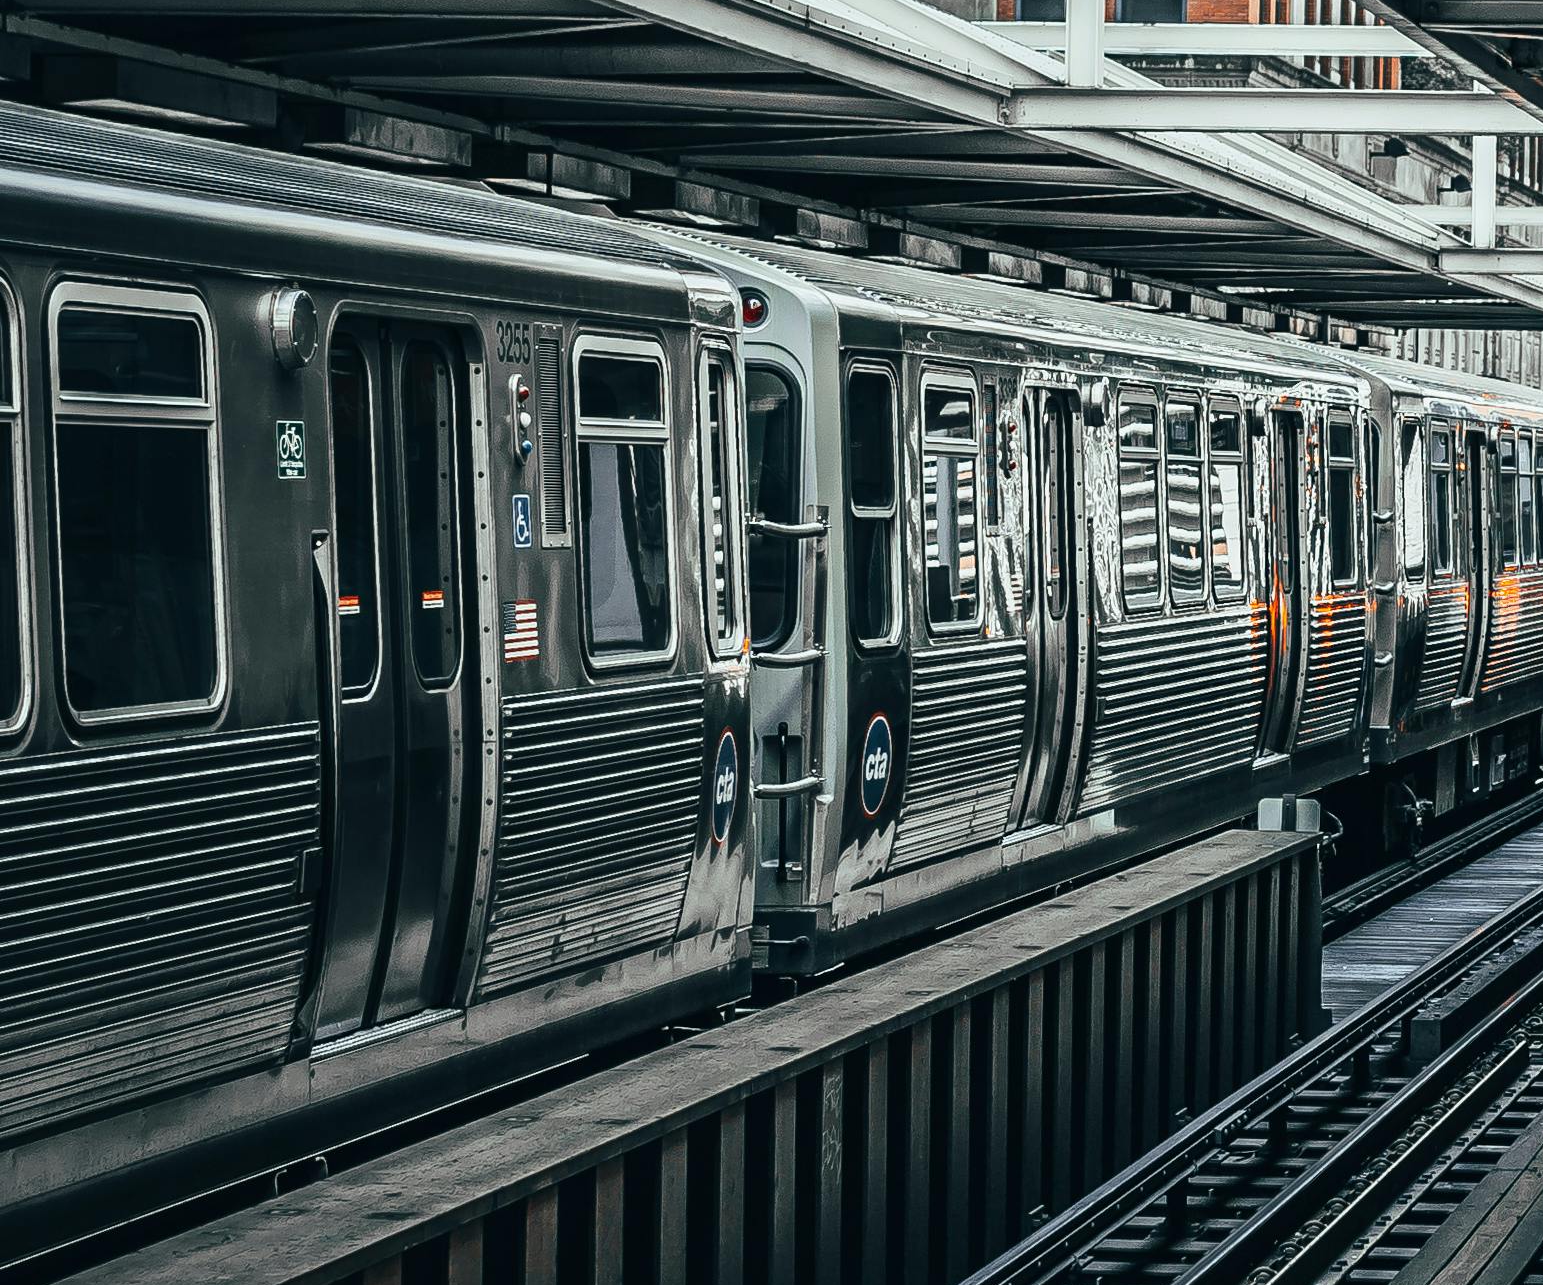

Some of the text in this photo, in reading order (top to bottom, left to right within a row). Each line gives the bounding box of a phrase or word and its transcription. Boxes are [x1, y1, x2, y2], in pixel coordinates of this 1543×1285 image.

[496, 320, 531, 365] 3255
[866, 747, 888, 781] cta
[716, 766, 734, 805] cta
